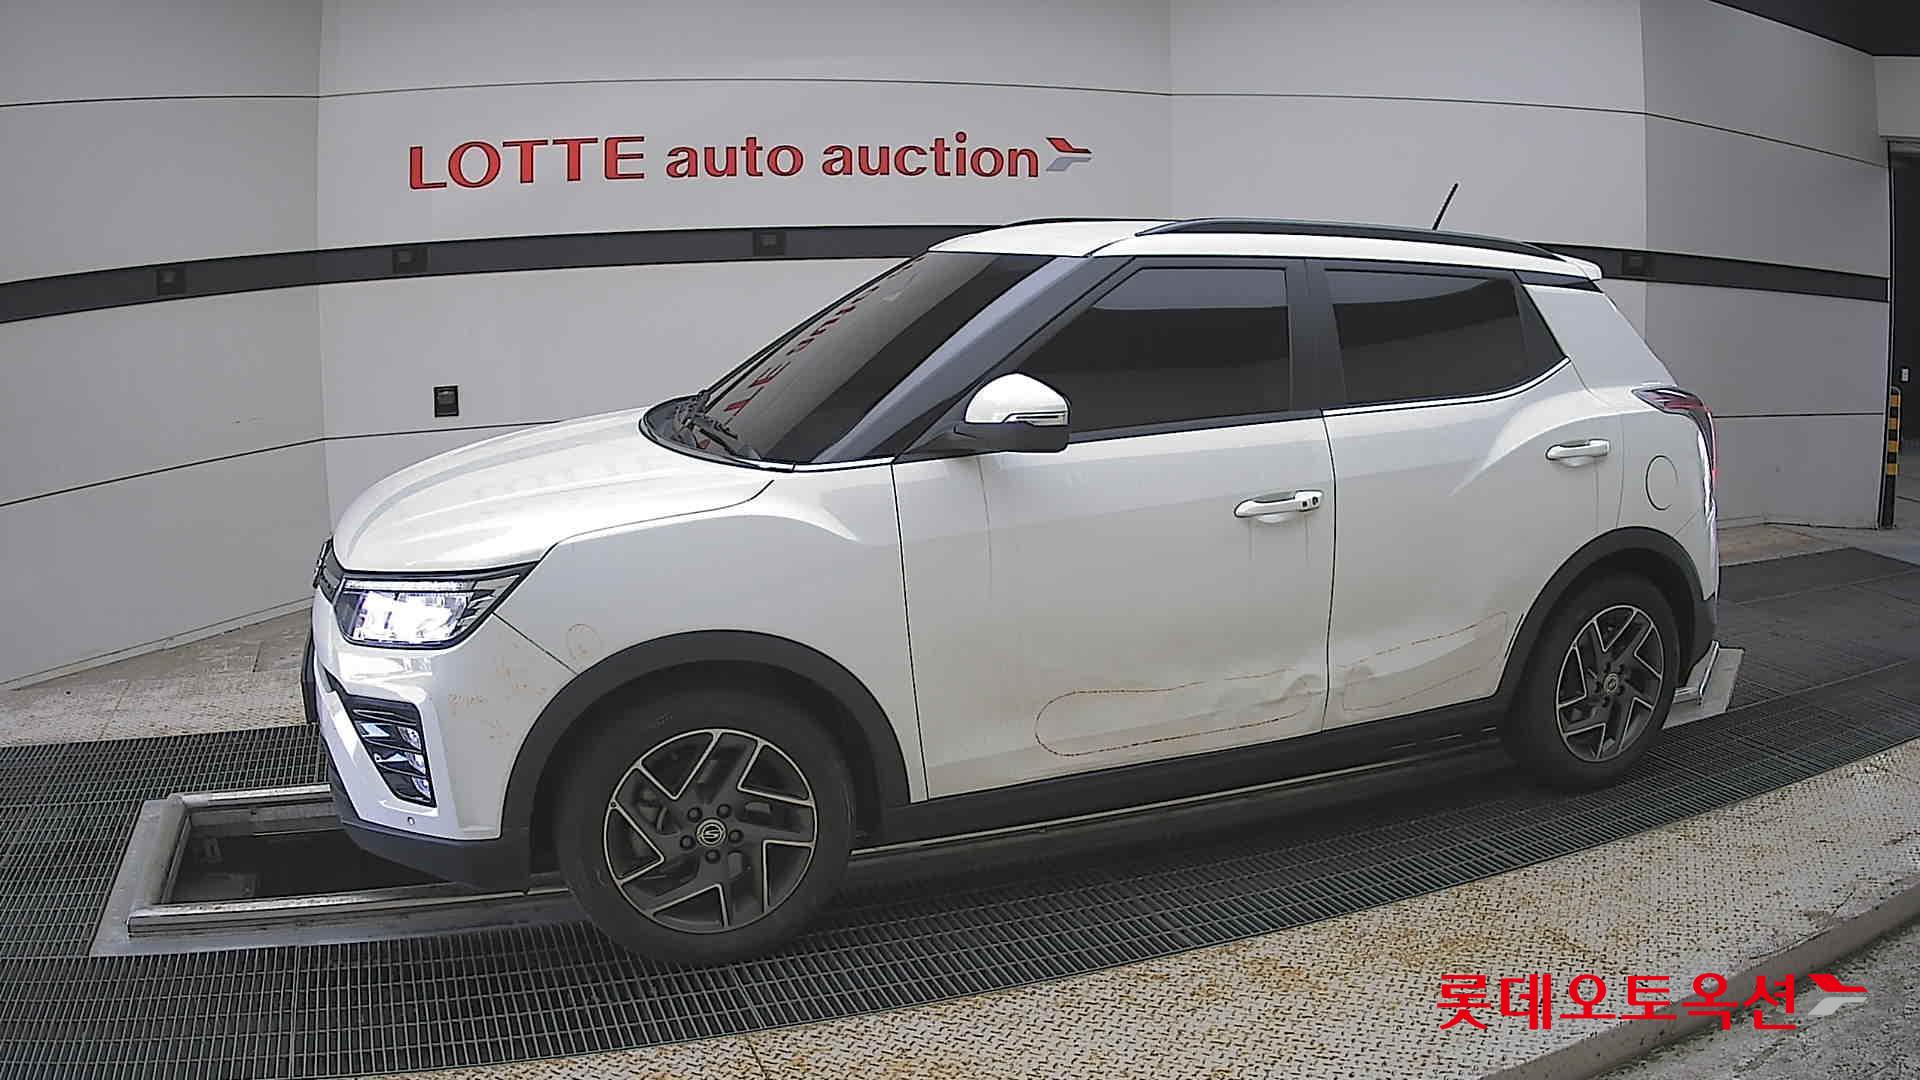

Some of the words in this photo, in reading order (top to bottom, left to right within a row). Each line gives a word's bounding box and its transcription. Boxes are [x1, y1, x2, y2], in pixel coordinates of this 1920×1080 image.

[408, 136, 646, 190] LOTTE
[665, 136, 804, 178] auto
[821, 131, 1040, 178] auction
